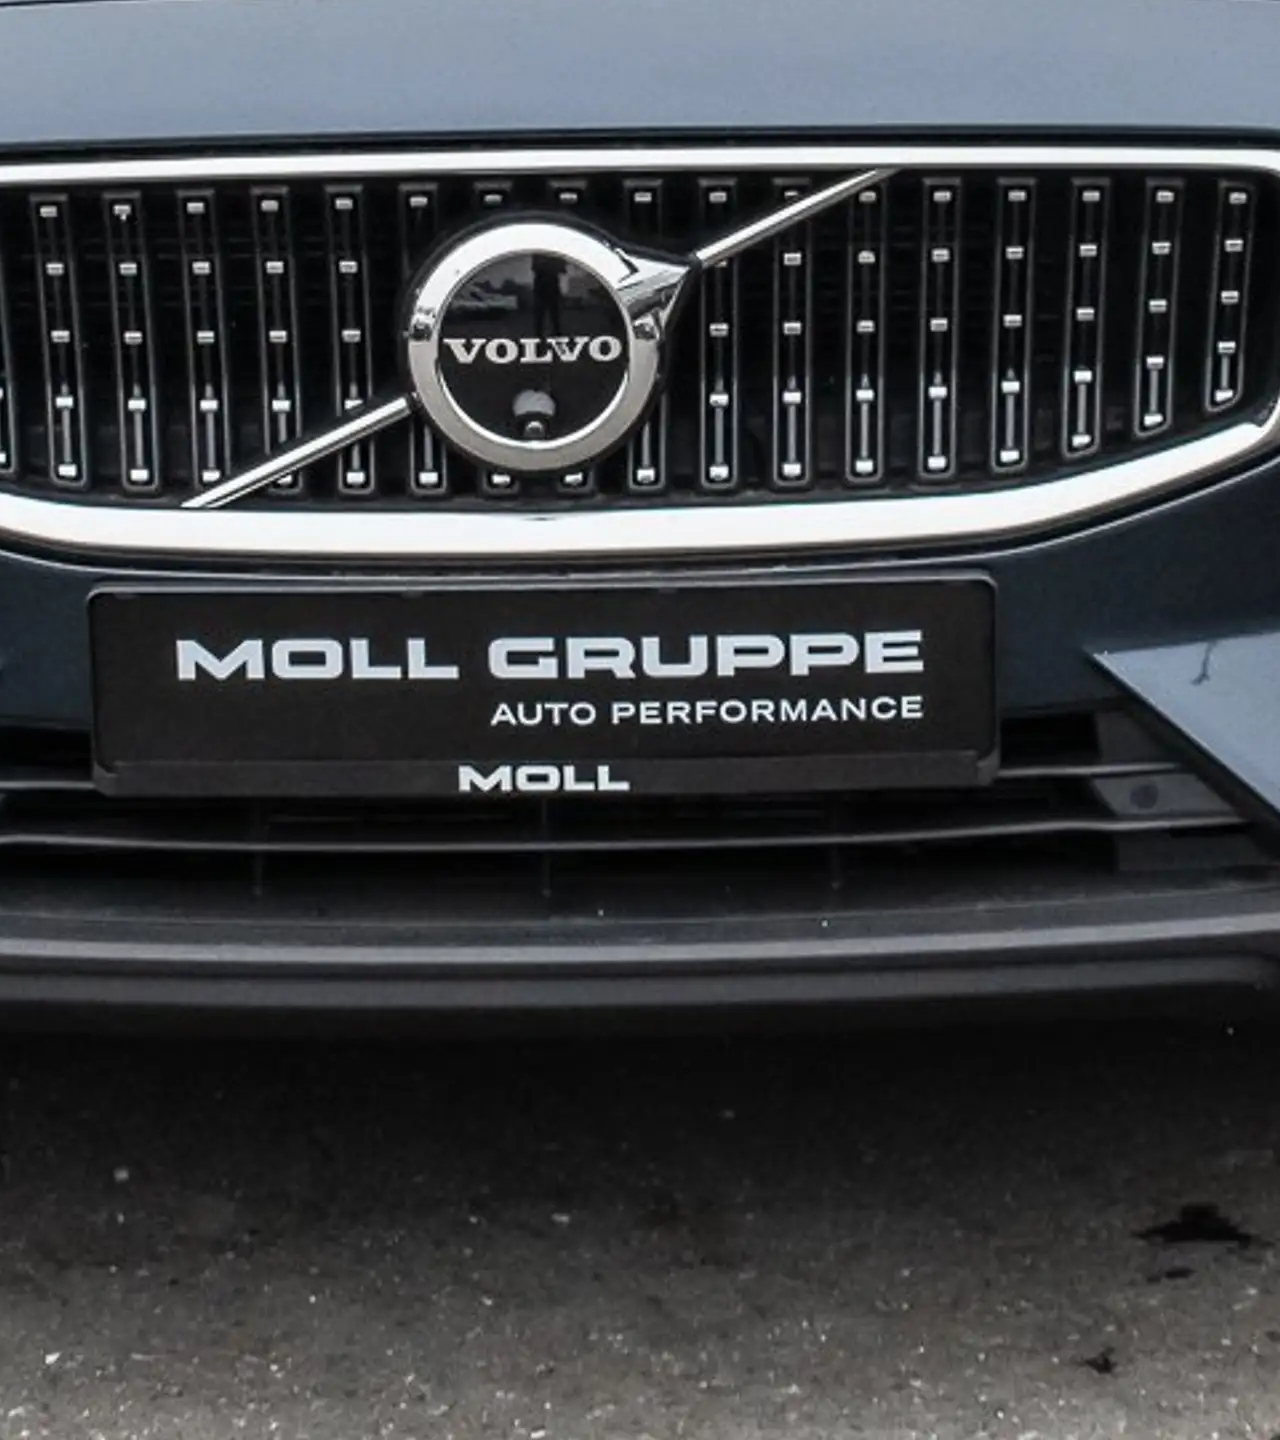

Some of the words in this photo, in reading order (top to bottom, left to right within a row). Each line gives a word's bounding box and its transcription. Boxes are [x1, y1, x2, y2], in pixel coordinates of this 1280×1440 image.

[443, 335, 621, 364] VOLVO
[176, 638, 460, 680] MOLL
[488, 629, 924, 679] GRUPPE
[490, 701, 597, 726] AUTO
[611, 695, 923, 725] PERFORMANCE
[458, 765, 630, 792] MOLL
